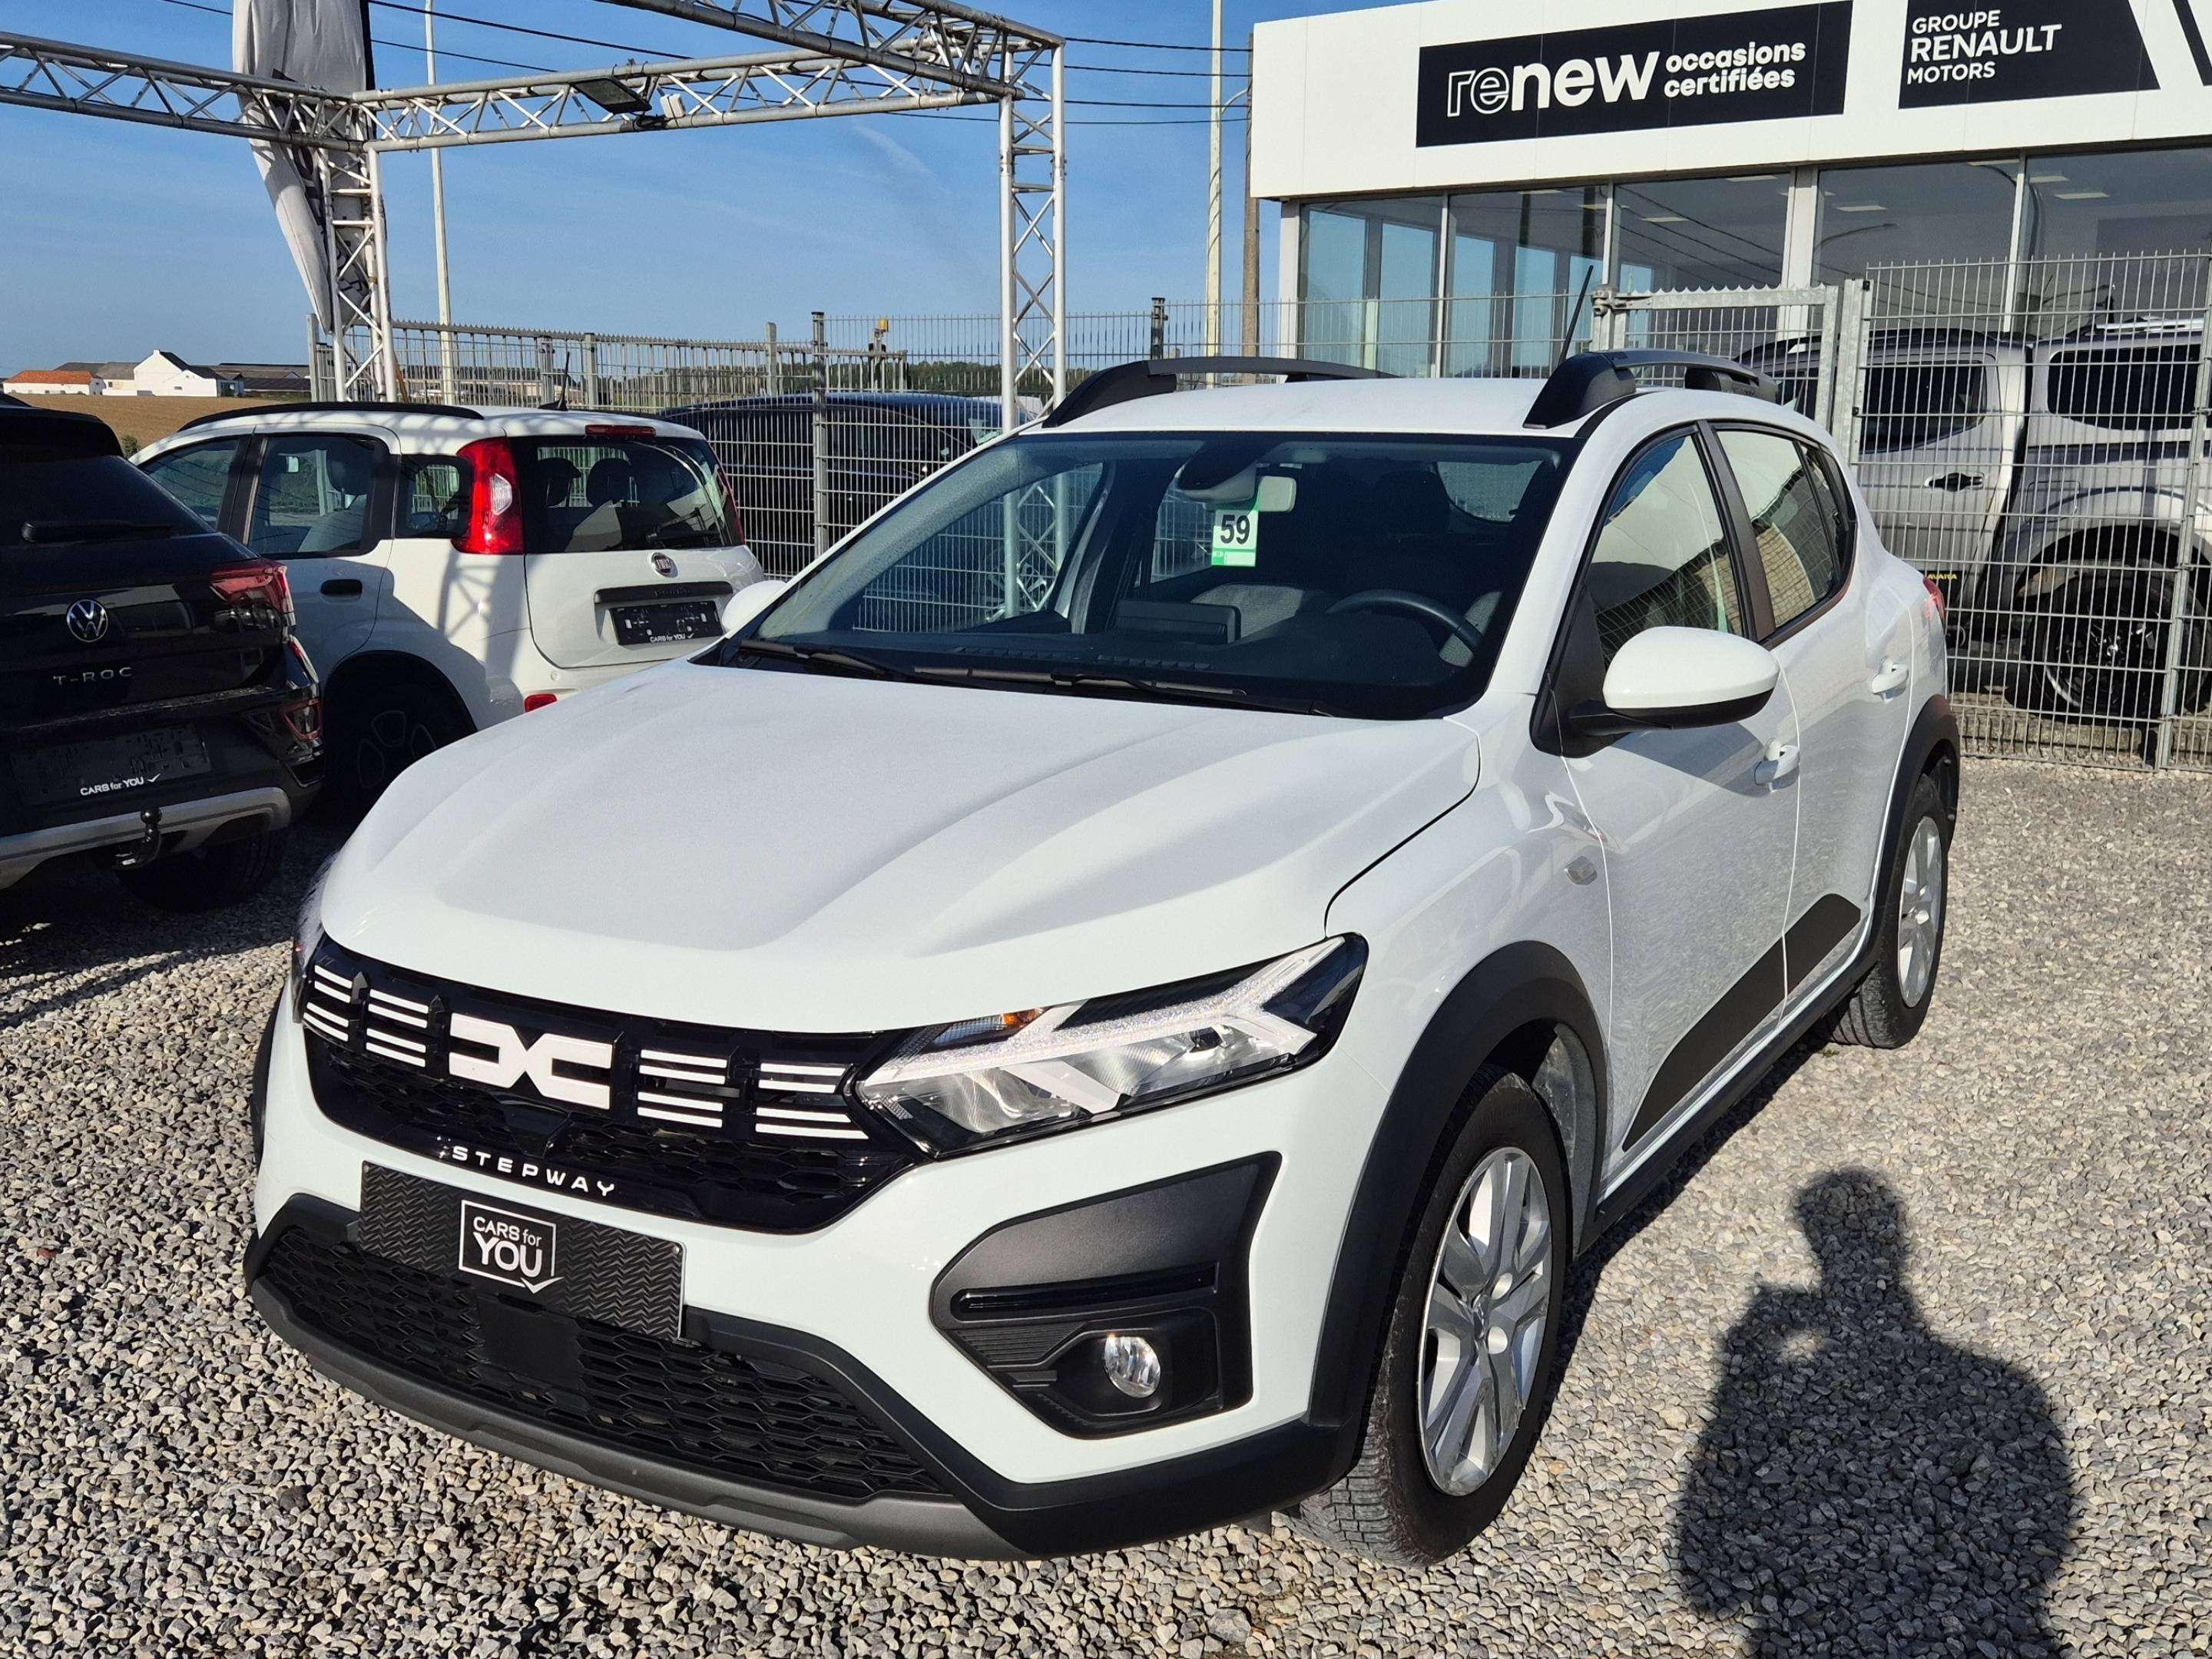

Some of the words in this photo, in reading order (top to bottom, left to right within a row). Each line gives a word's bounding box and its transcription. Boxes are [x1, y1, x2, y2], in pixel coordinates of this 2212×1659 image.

[1912, 9, 2002, 35] GROUPE
[1665, 41, 1806, 74] occasions
[1910, 23, 2063, 63] RENAULT
[1446, 51, 1661, 118] renew
[1664, 66, 1796, 98] certifiées
[1906, 61, 1996, 85] MOTORS
[1220, 514, 1251, 545] 59
[52, 667, 133, 686] T-ROC
[80, 783, 110, 796] CARS
[110, 782, 123, 790] for
[122, 776, 144, 788] YOU
[452, 1144, 615, 1197] STEPWAY
[472, 1216, 520, 1242] CARS
[522, 1229, 543, 1247] for
[472, 1231, 543, 1278] YOU
